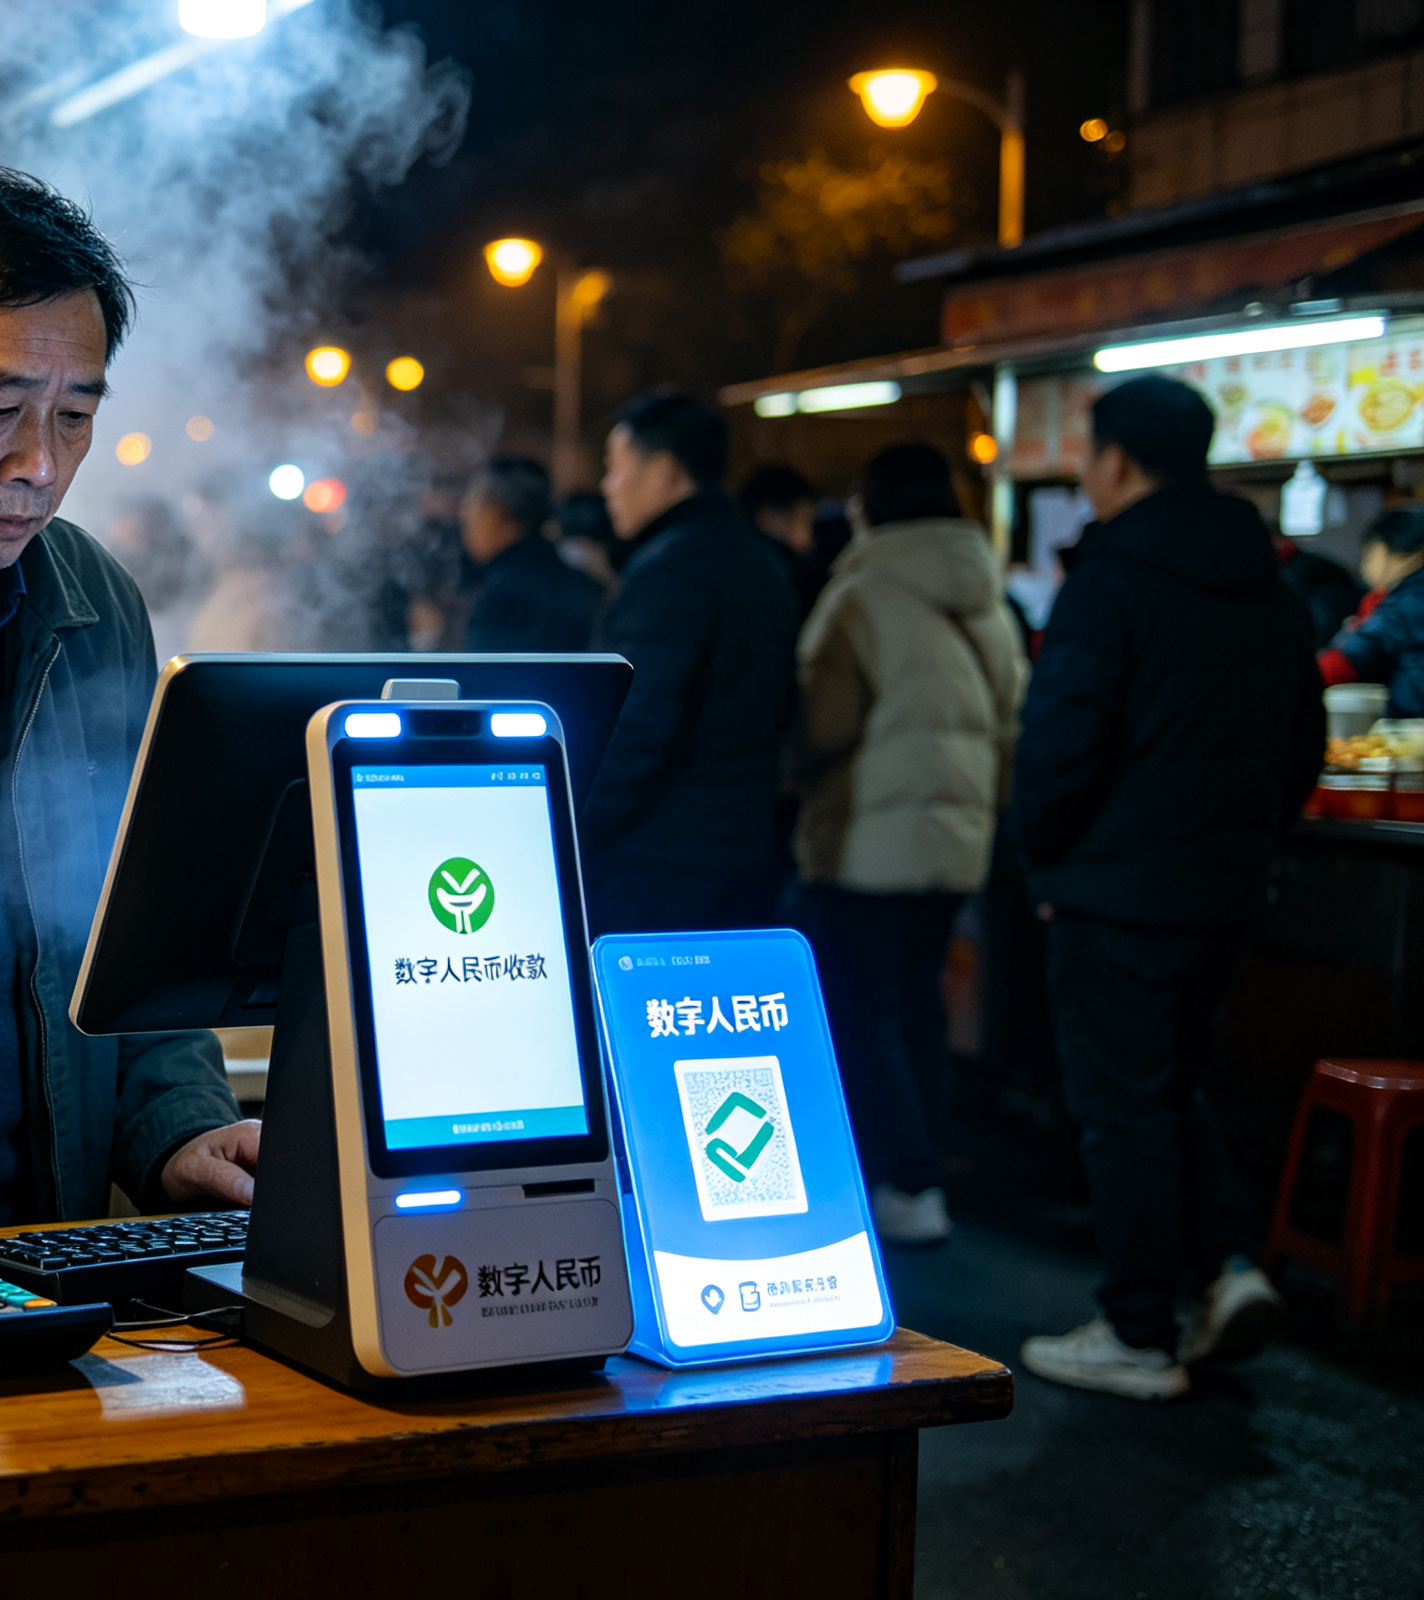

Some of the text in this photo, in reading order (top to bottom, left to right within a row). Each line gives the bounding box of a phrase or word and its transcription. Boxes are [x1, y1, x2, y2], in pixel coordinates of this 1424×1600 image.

[646, 992, 790, 1038] 数字人民币
[478, 1255, 602, 1299] 数字人民币
